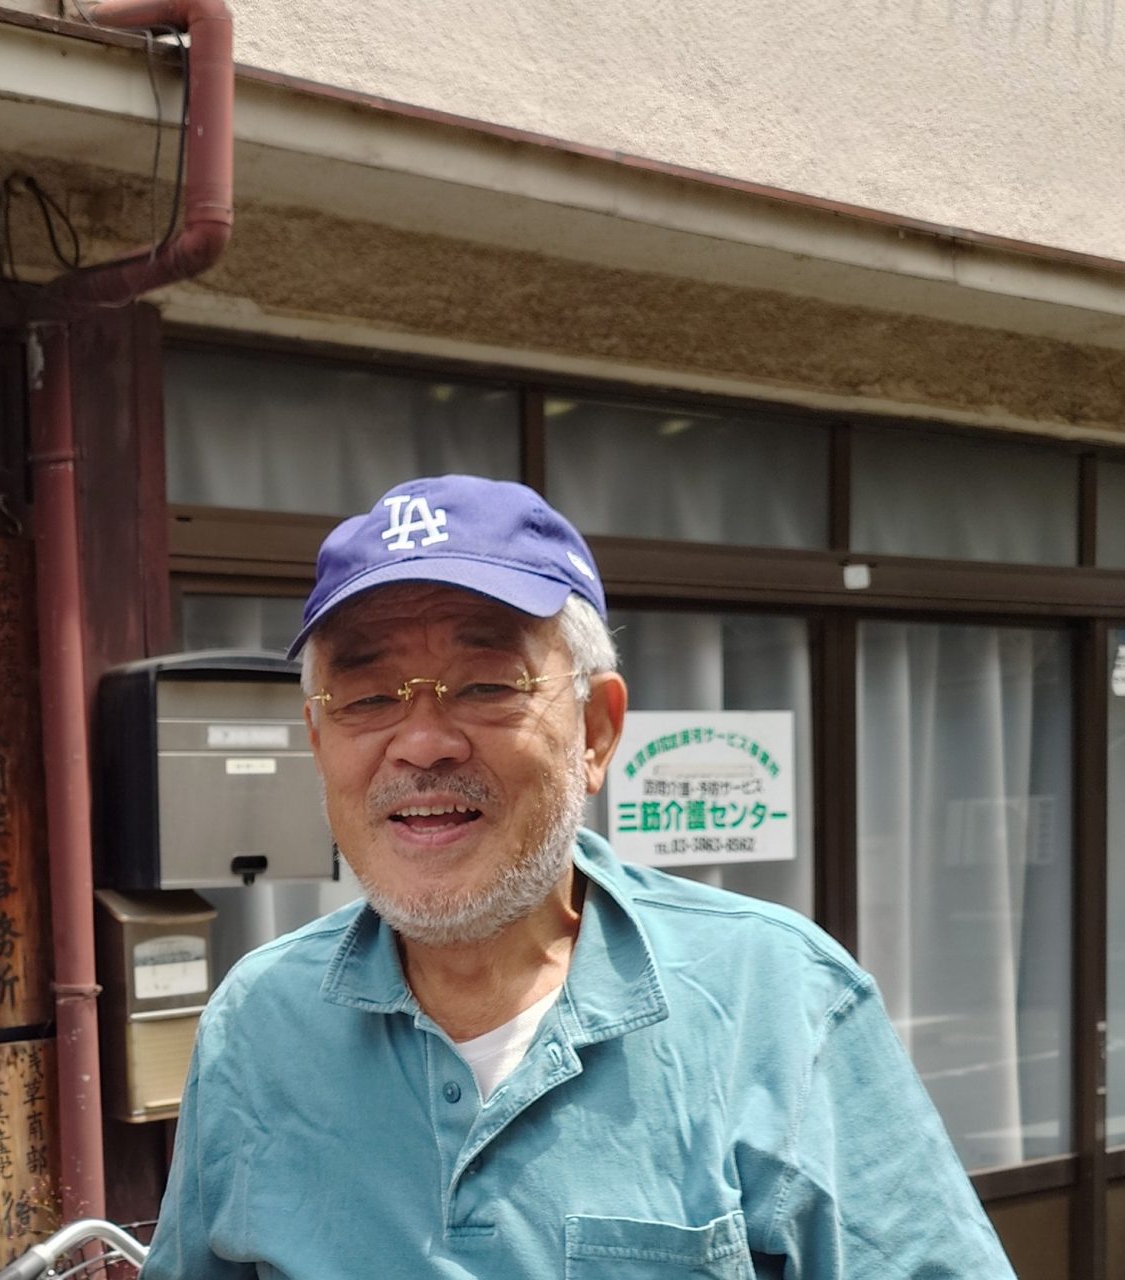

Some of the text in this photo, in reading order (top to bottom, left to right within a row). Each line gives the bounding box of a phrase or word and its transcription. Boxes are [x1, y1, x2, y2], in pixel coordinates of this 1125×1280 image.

[381, 495, 449, 551] LA
[617, 799, 788, 833] 三筋介護センター
